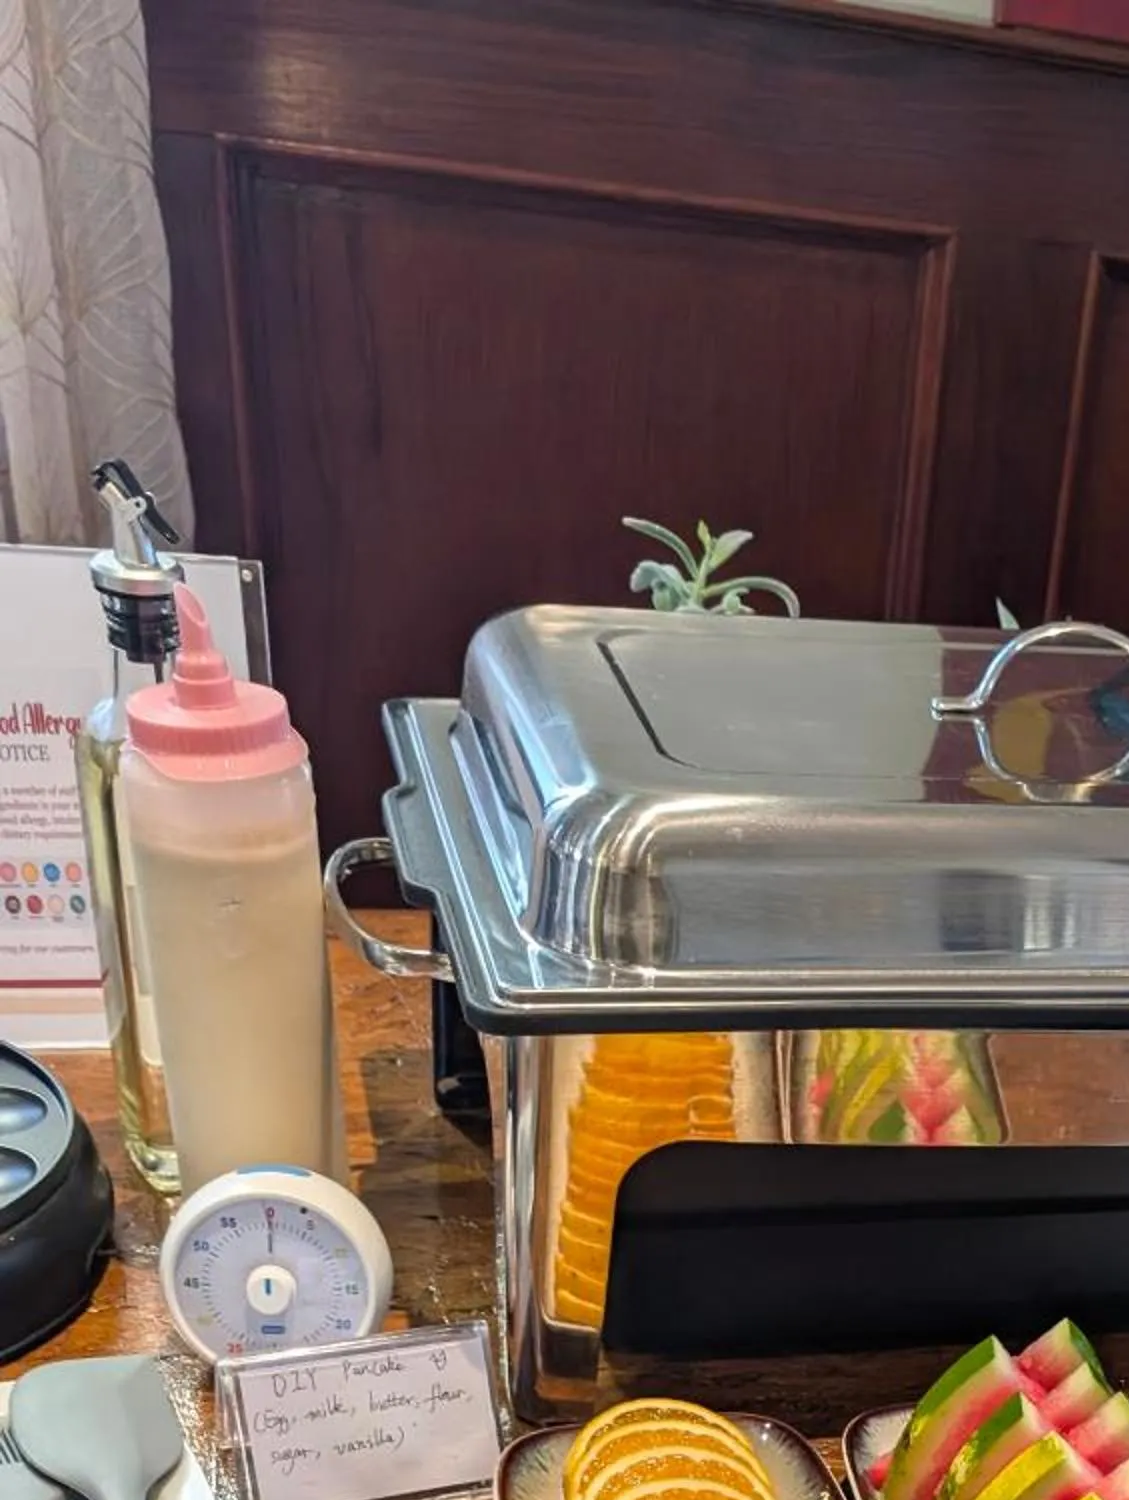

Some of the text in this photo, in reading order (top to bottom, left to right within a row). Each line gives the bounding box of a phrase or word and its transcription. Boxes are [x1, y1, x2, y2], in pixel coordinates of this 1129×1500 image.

[22, 702, 82, 749] Allerg
[220, 1216, 237, 1229] 55
[193, 1239, 210, 1252] 50
[183, 1276, 200, 1289] 45
[345, 1283, 360, 1296] 15
[271, 1367, 318, 1399] DIY
